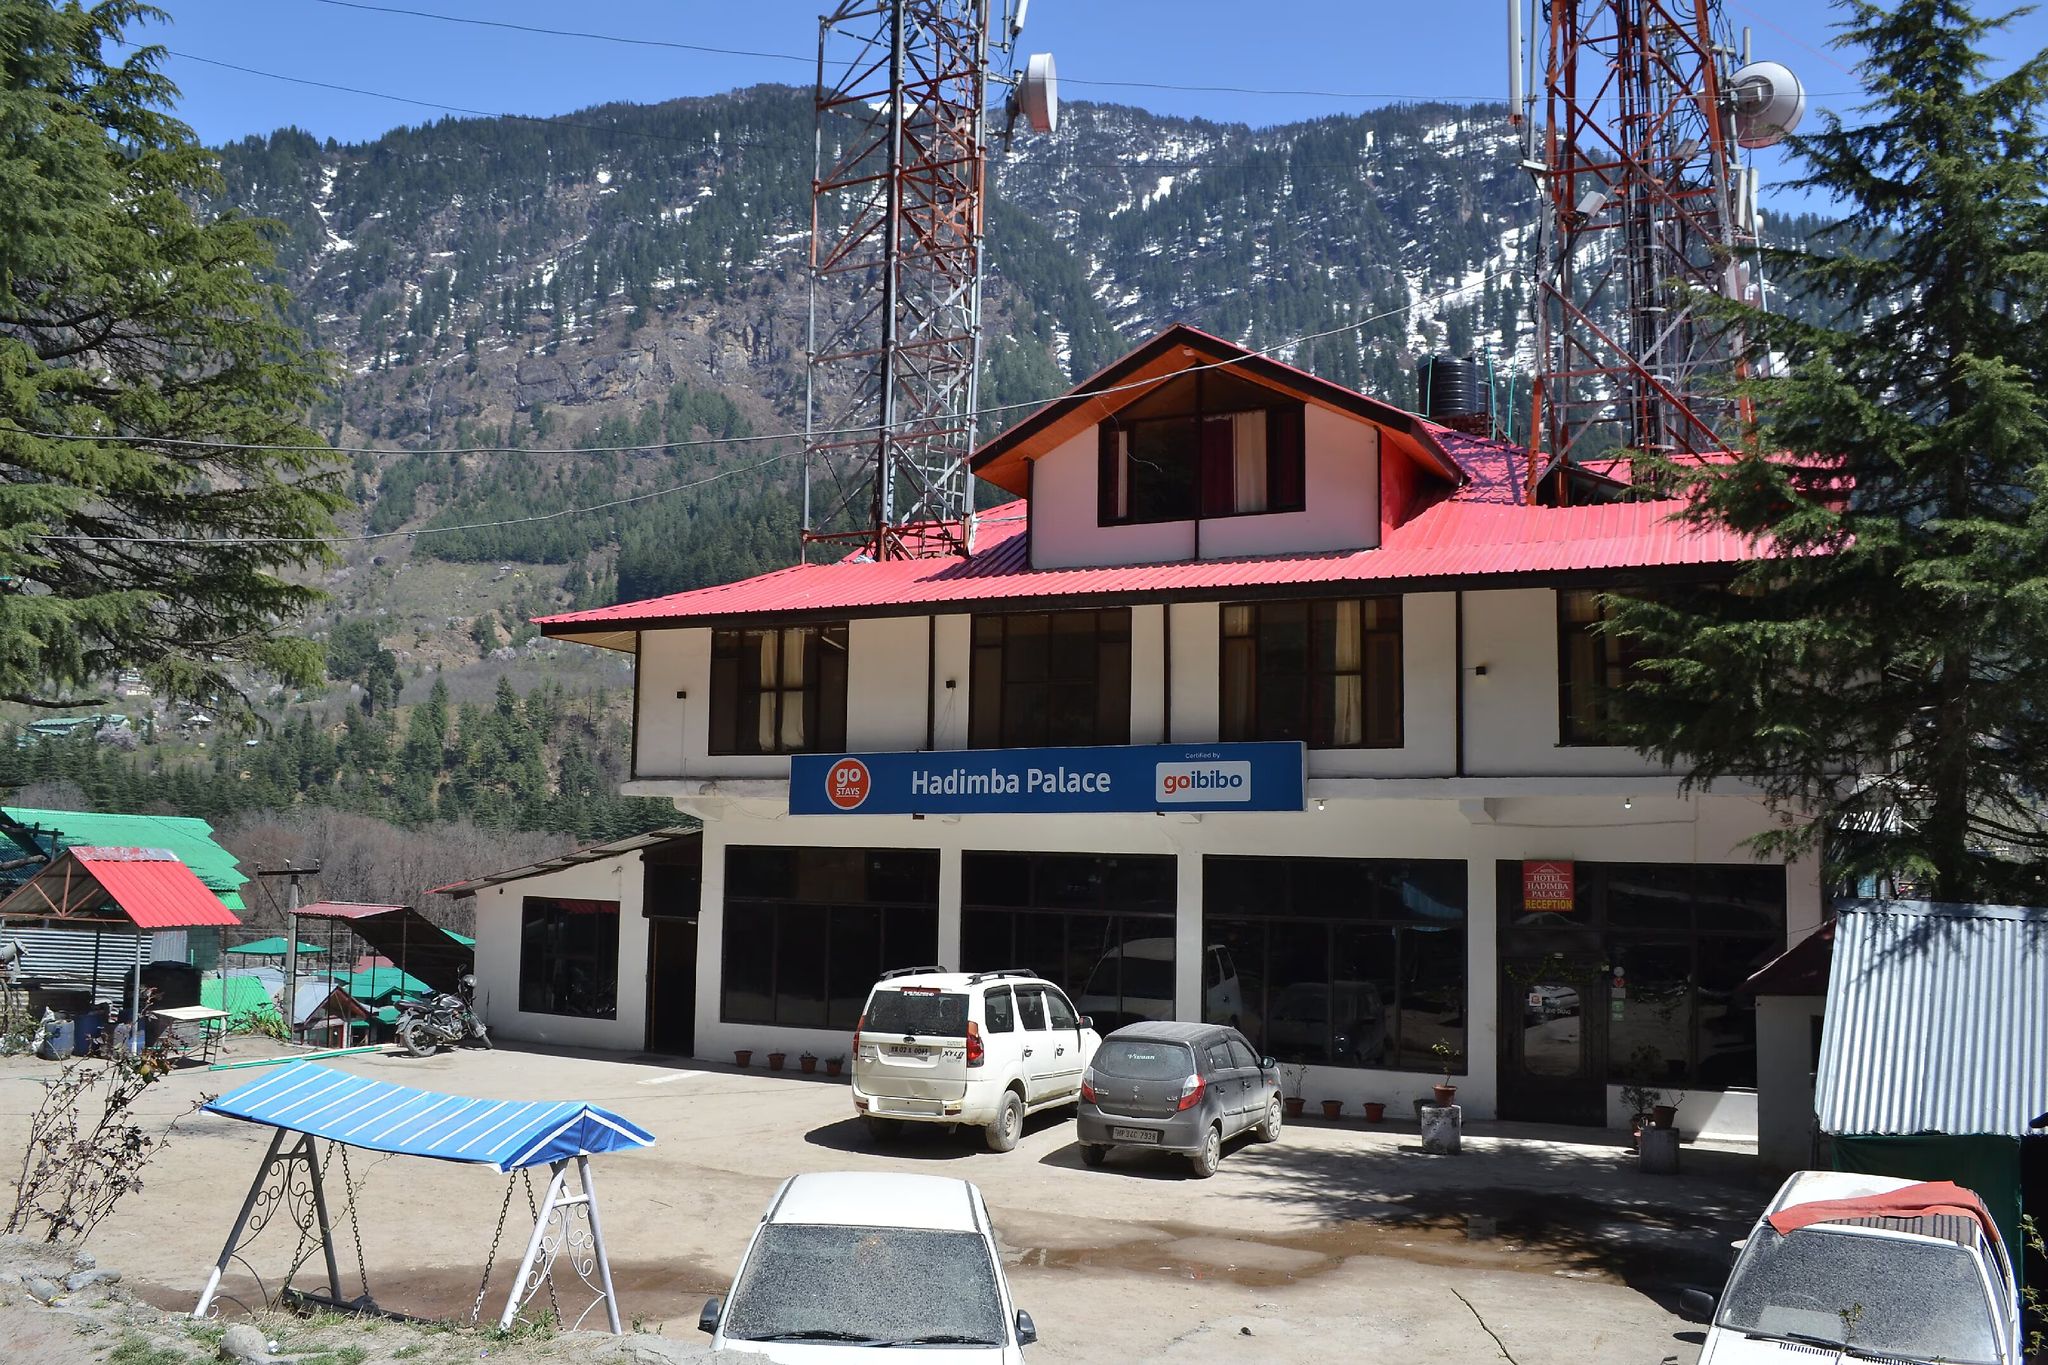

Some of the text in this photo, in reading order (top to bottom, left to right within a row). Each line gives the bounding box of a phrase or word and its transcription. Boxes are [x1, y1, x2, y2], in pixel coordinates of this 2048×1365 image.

[836, 768, 861, 788] go
[912, 766, 1111, 795] Hadimba Palace
[1163, 770, 1243, 794] goibibo
[836, 787, 860, 796] STAYS
[1533, 874, 1562, 882] HOTEL
[1528, 882, 1569, 890] HADIMBA
[1532, 890, 1565, 898] PALACE
[1525, 899, 1573, 910] RECEPTION
